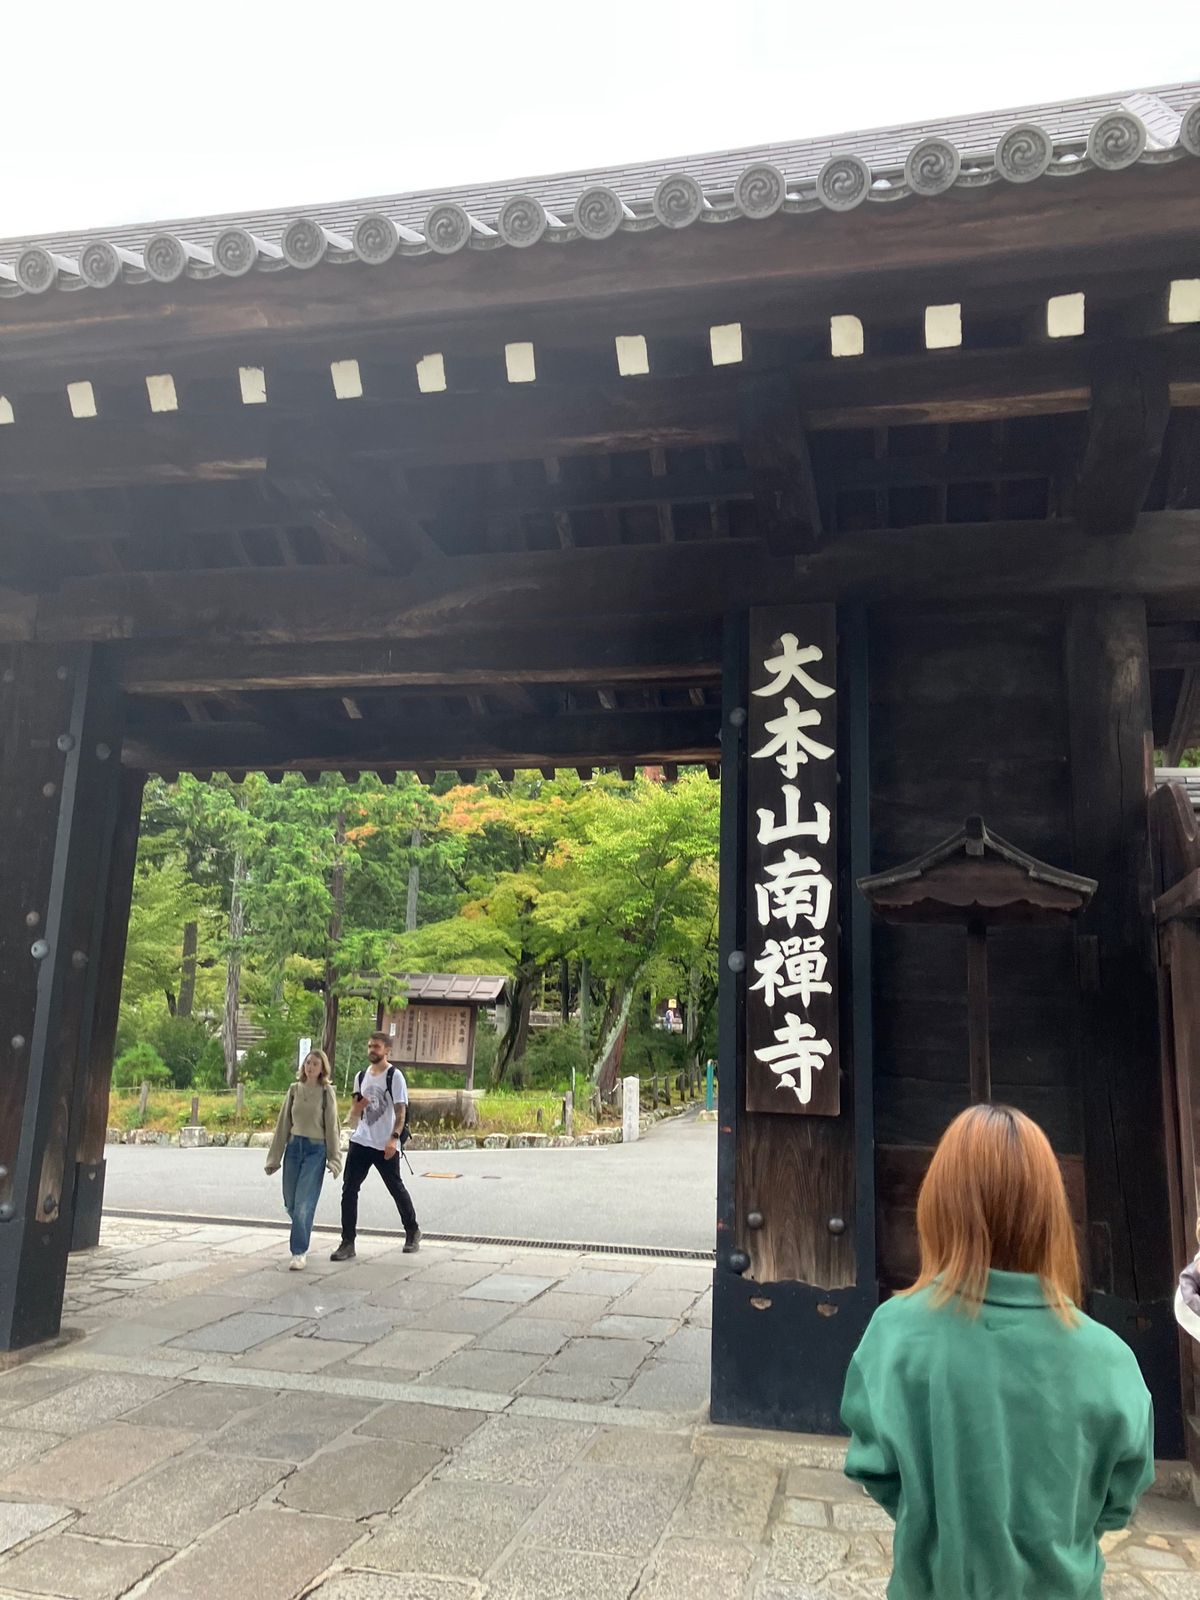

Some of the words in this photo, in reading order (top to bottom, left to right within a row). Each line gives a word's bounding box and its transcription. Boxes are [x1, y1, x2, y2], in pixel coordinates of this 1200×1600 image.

[748, 632, 836, 1104] 大本山南禪寺
